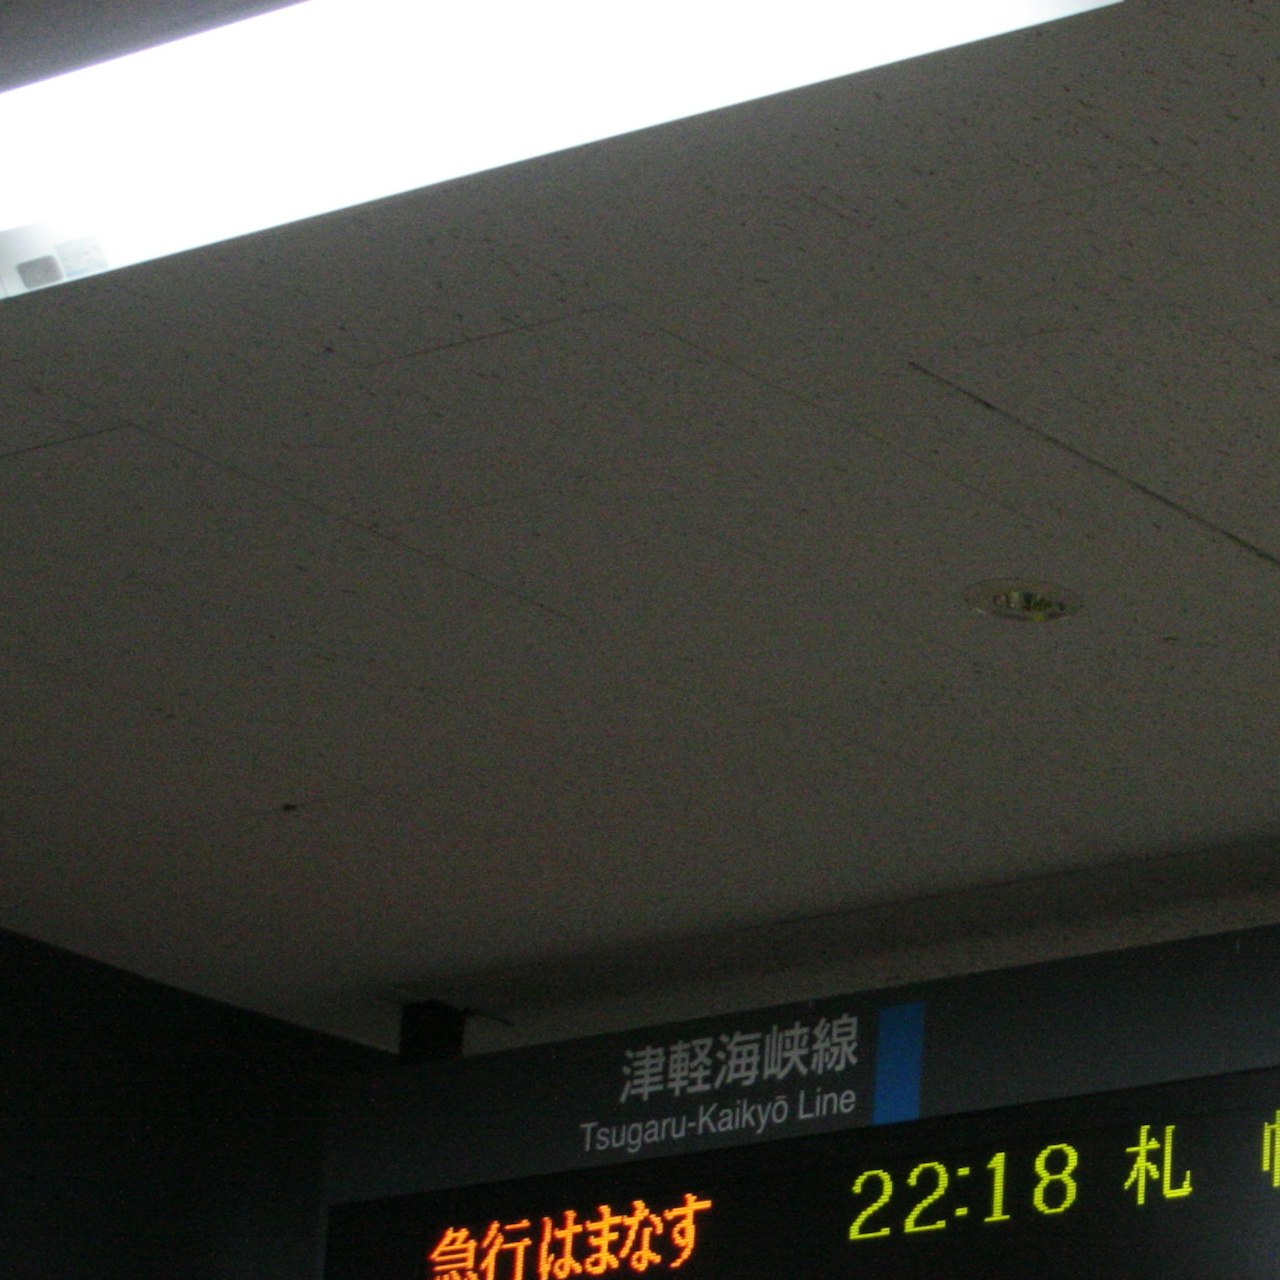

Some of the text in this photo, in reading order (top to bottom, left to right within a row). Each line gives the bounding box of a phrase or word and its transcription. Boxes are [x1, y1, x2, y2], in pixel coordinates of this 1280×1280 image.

[620, 1012, 858, 1103] 津軽海峡線
[580, 1086, 857, 1154] Tsugaru-Kaikyō Line
[849, 1142, 1079, 1241] 22:18
